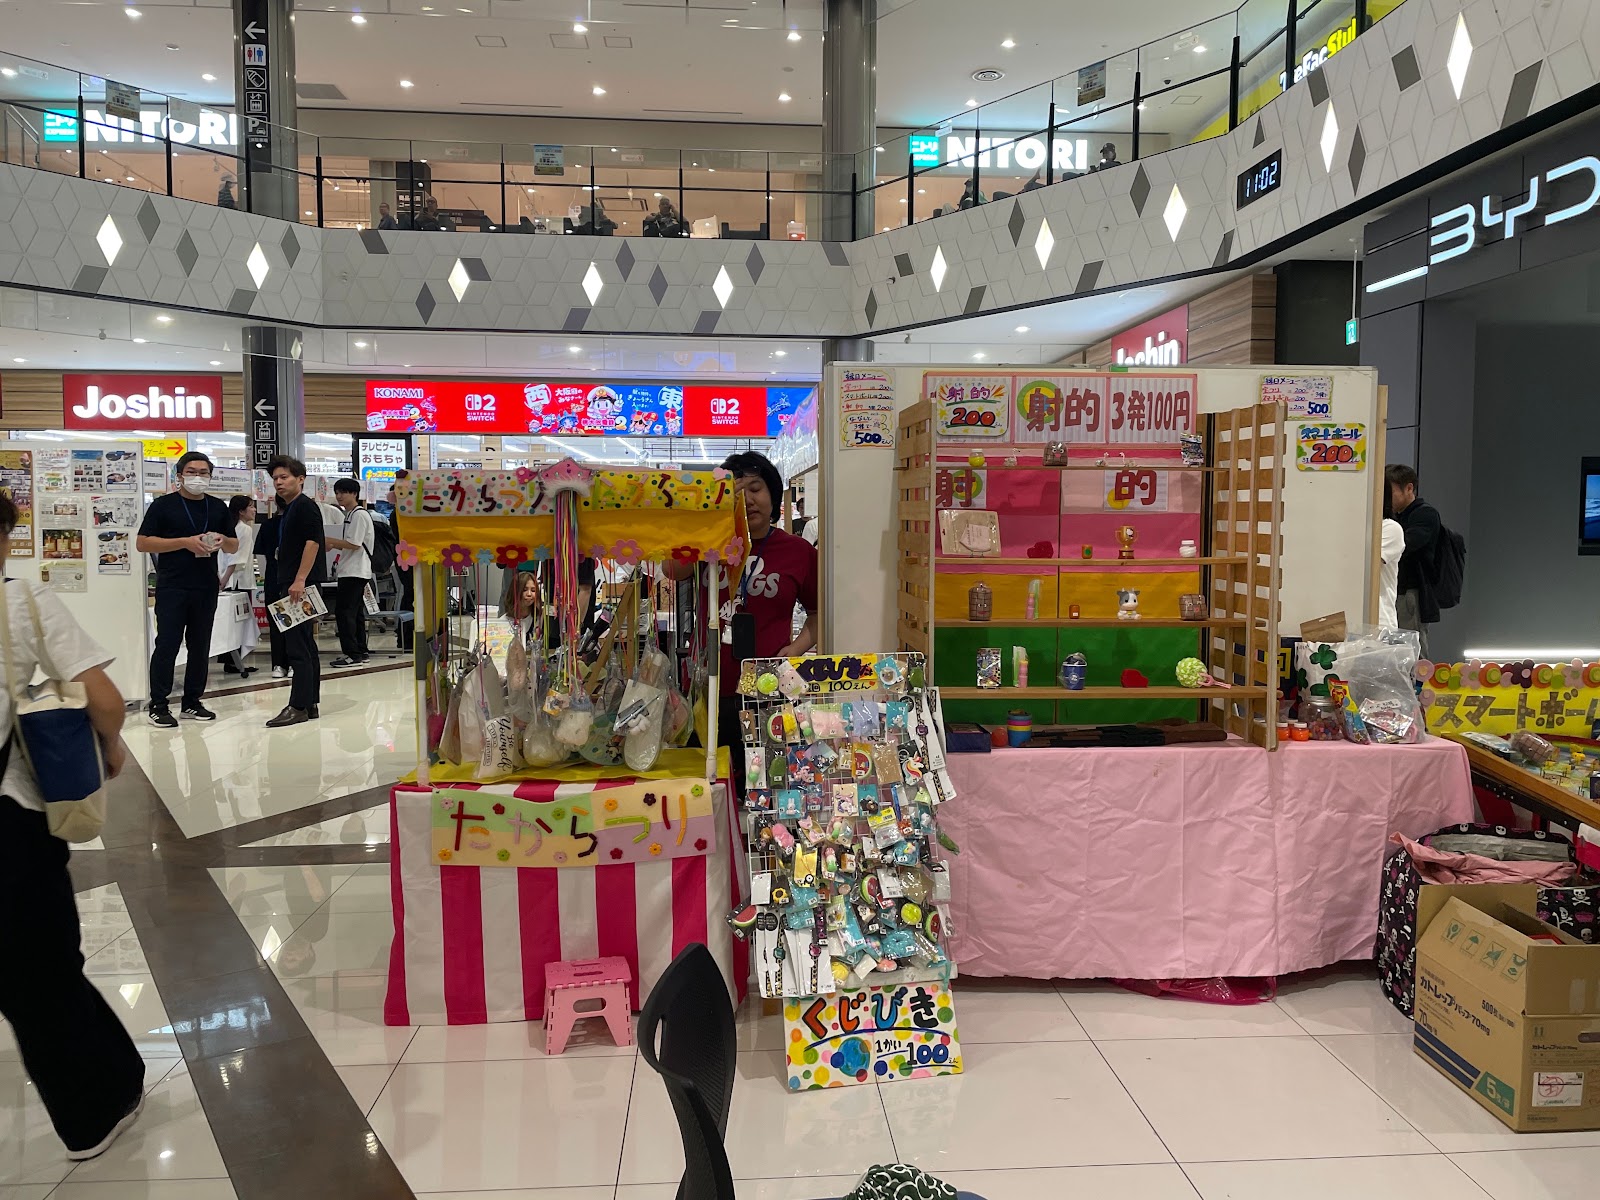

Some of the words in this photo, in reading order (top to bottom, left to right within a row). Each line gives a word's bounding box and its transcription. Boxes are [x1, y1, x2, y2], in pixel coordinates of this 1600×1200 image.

[947, 136, 1088, 169] NITORI
[1245, 161, 1279, 198] 11:02
[1430, 156, 1600, 264] BYD
[1117, 330, 1179, 365] hin
[72, 386, 212, 419] Joshin
[374, 387, 424, 398] KONAMI
[526, 384, 551, 407] 西
[658, 386, 683, 411] 東
[946, 386, 991, 402] 射的
[1026, 387, 1101, 432] 射的
[1111, 389, 1190, 431] 3発100円
[1307, 401, 1329, 415] 500
[361, 442, 403, 451] テレビゲーム
[1301, 427, 1363, 440] スマートボール
[362, 454, 403, 464] おもちゃ
[936, 468, 976, 508] 射
[1115, 469, 1157, 506] 的
[449, 793, 688, 859] たからつり
[801, 986, 939, 1039] くじびき
[875, 1038, 902, 1053] 1かい
